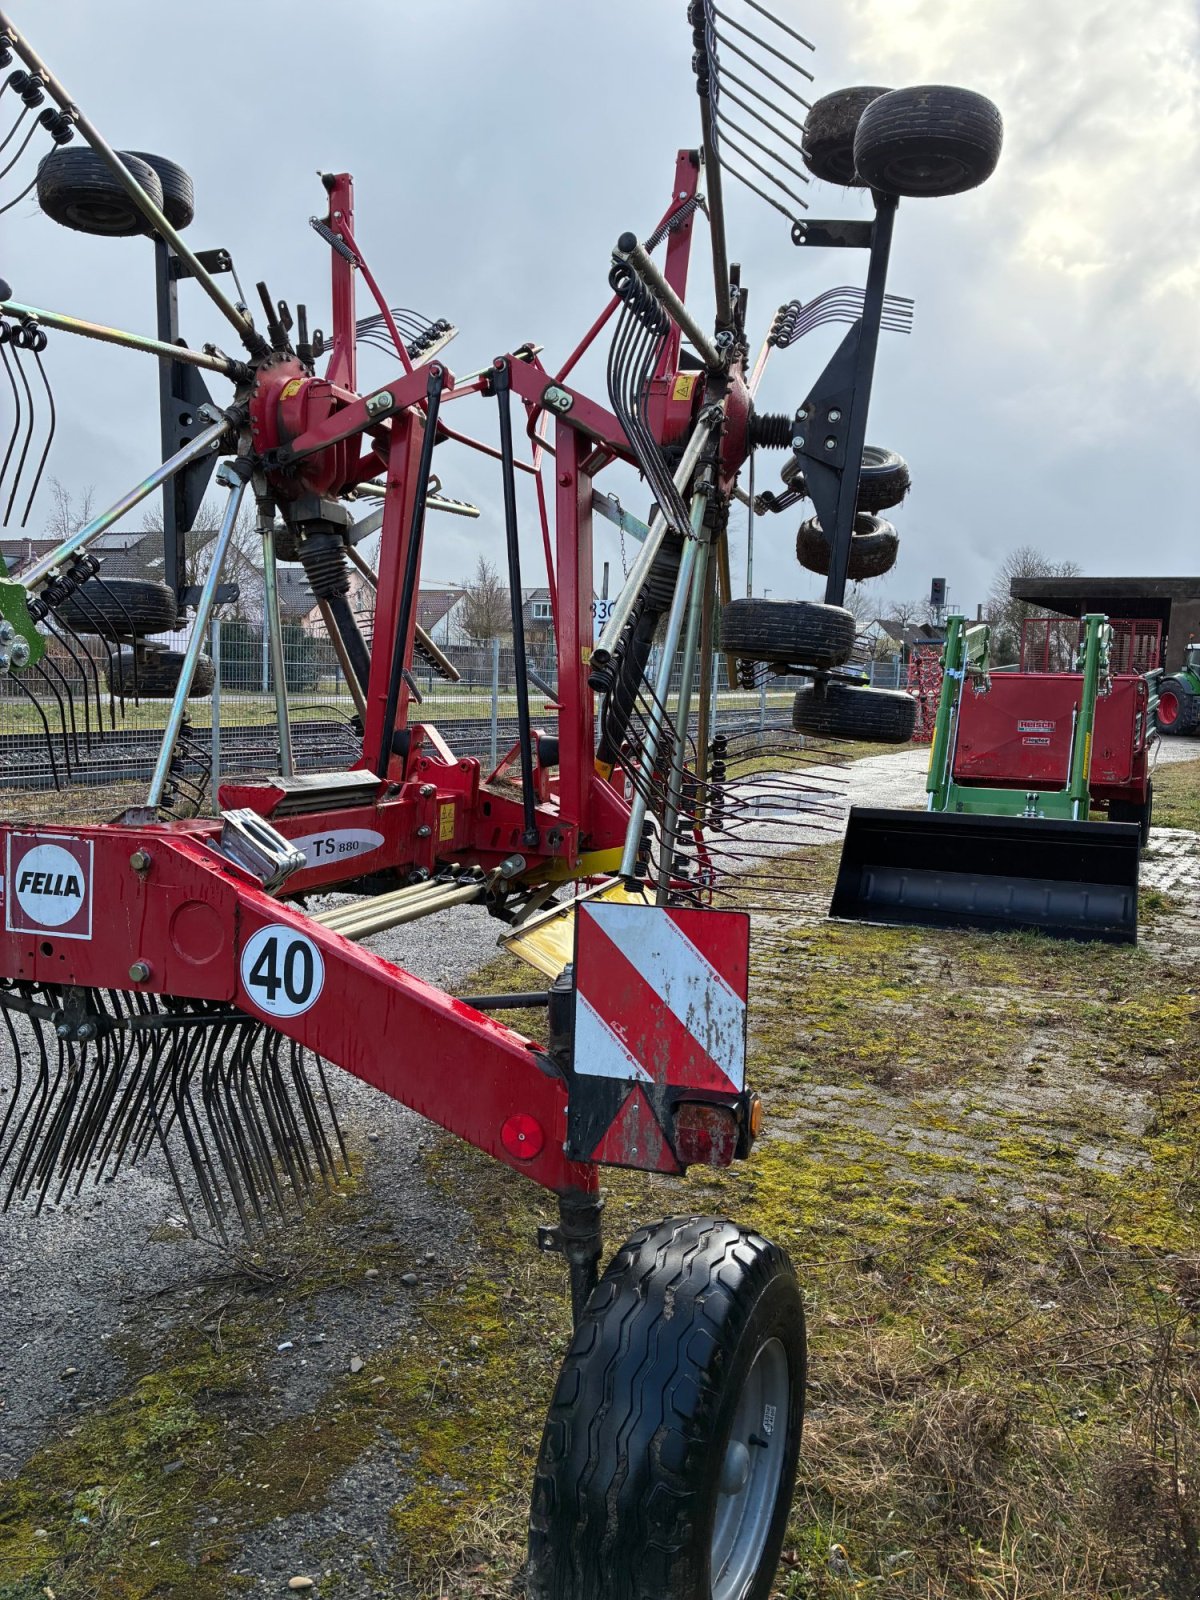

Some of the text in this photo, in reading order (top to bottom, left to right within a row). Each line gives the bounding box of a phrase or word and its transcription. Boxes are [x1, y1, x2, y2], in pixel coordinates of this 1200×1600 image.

[313, 838, 359, 856] TS 880
[18, 871, 81, 898] FELLA
[249, 937, 314, 1004] 40
